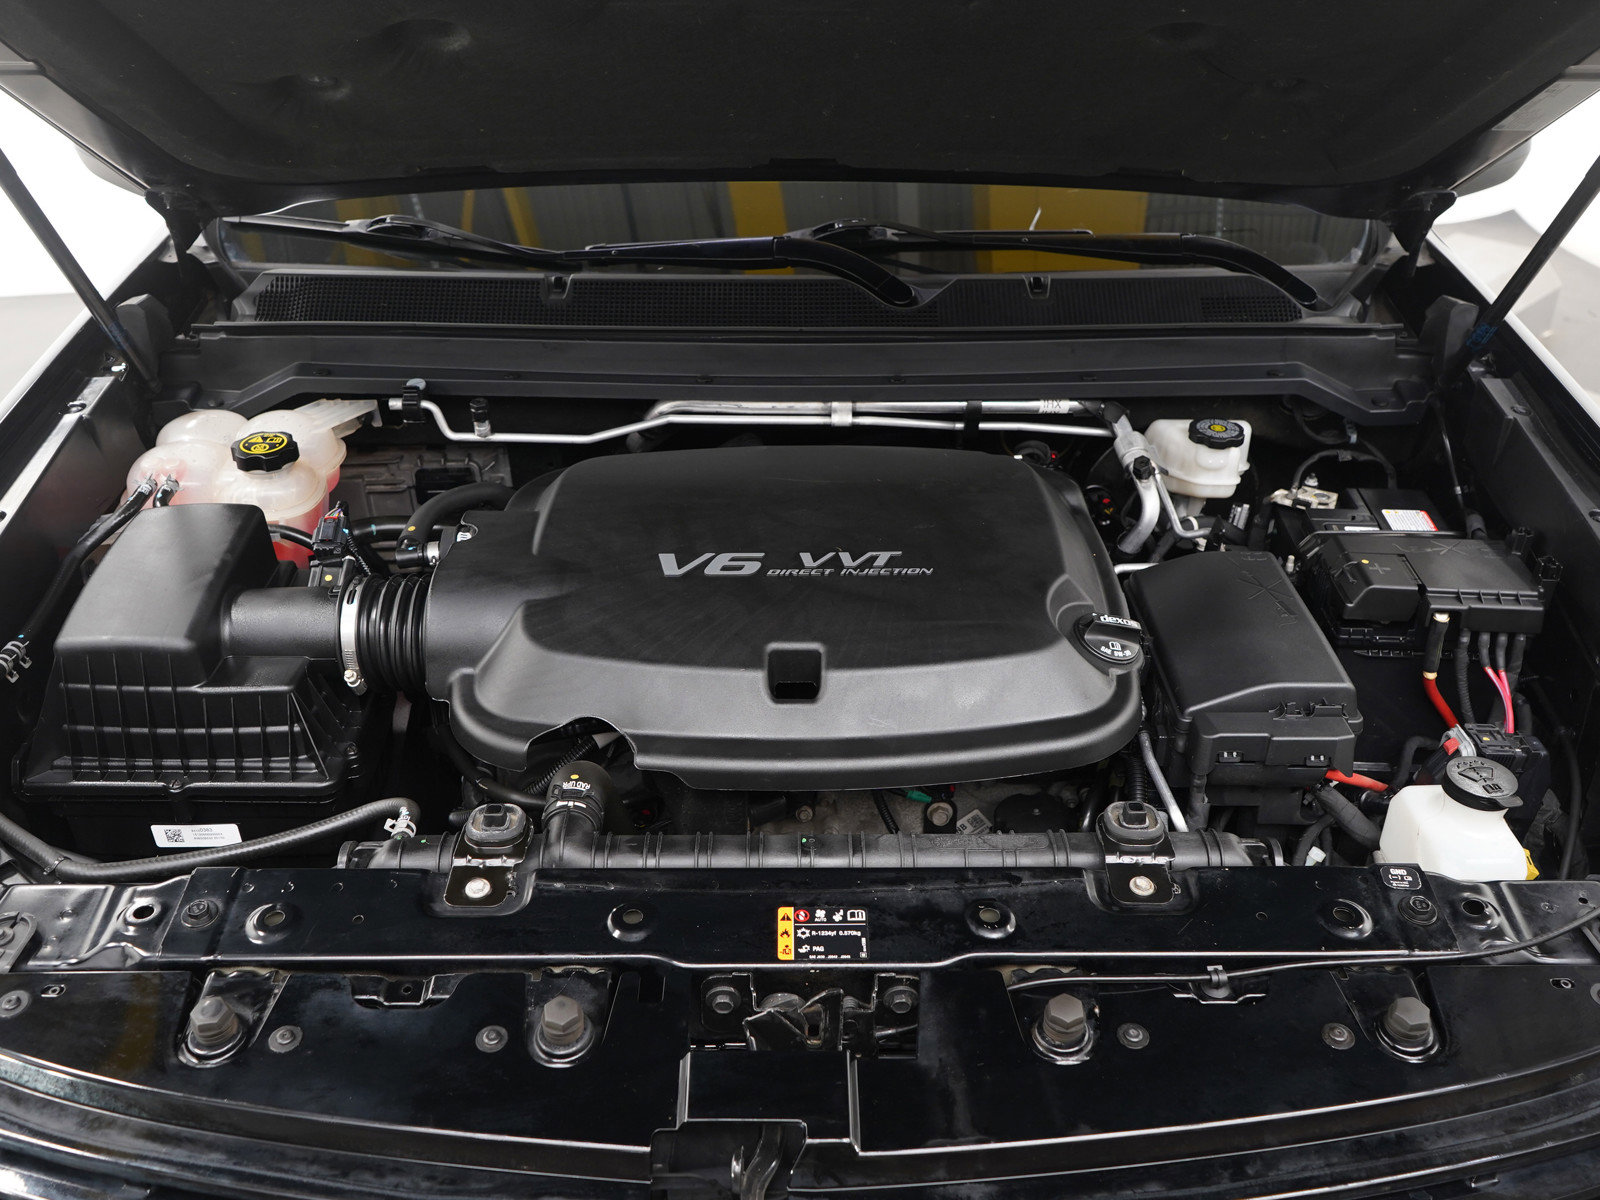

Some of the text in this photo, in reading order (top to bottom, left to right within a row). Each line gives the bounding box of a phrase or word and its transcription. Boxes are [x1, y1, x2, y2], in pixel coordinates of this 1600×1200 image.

[658, 552, 766, 577] V6
[799, 550, 902, 568] VVT
[766, 566, 935, 577] DIRECT INJECTION
[576, 780, 591, 790] RAD
